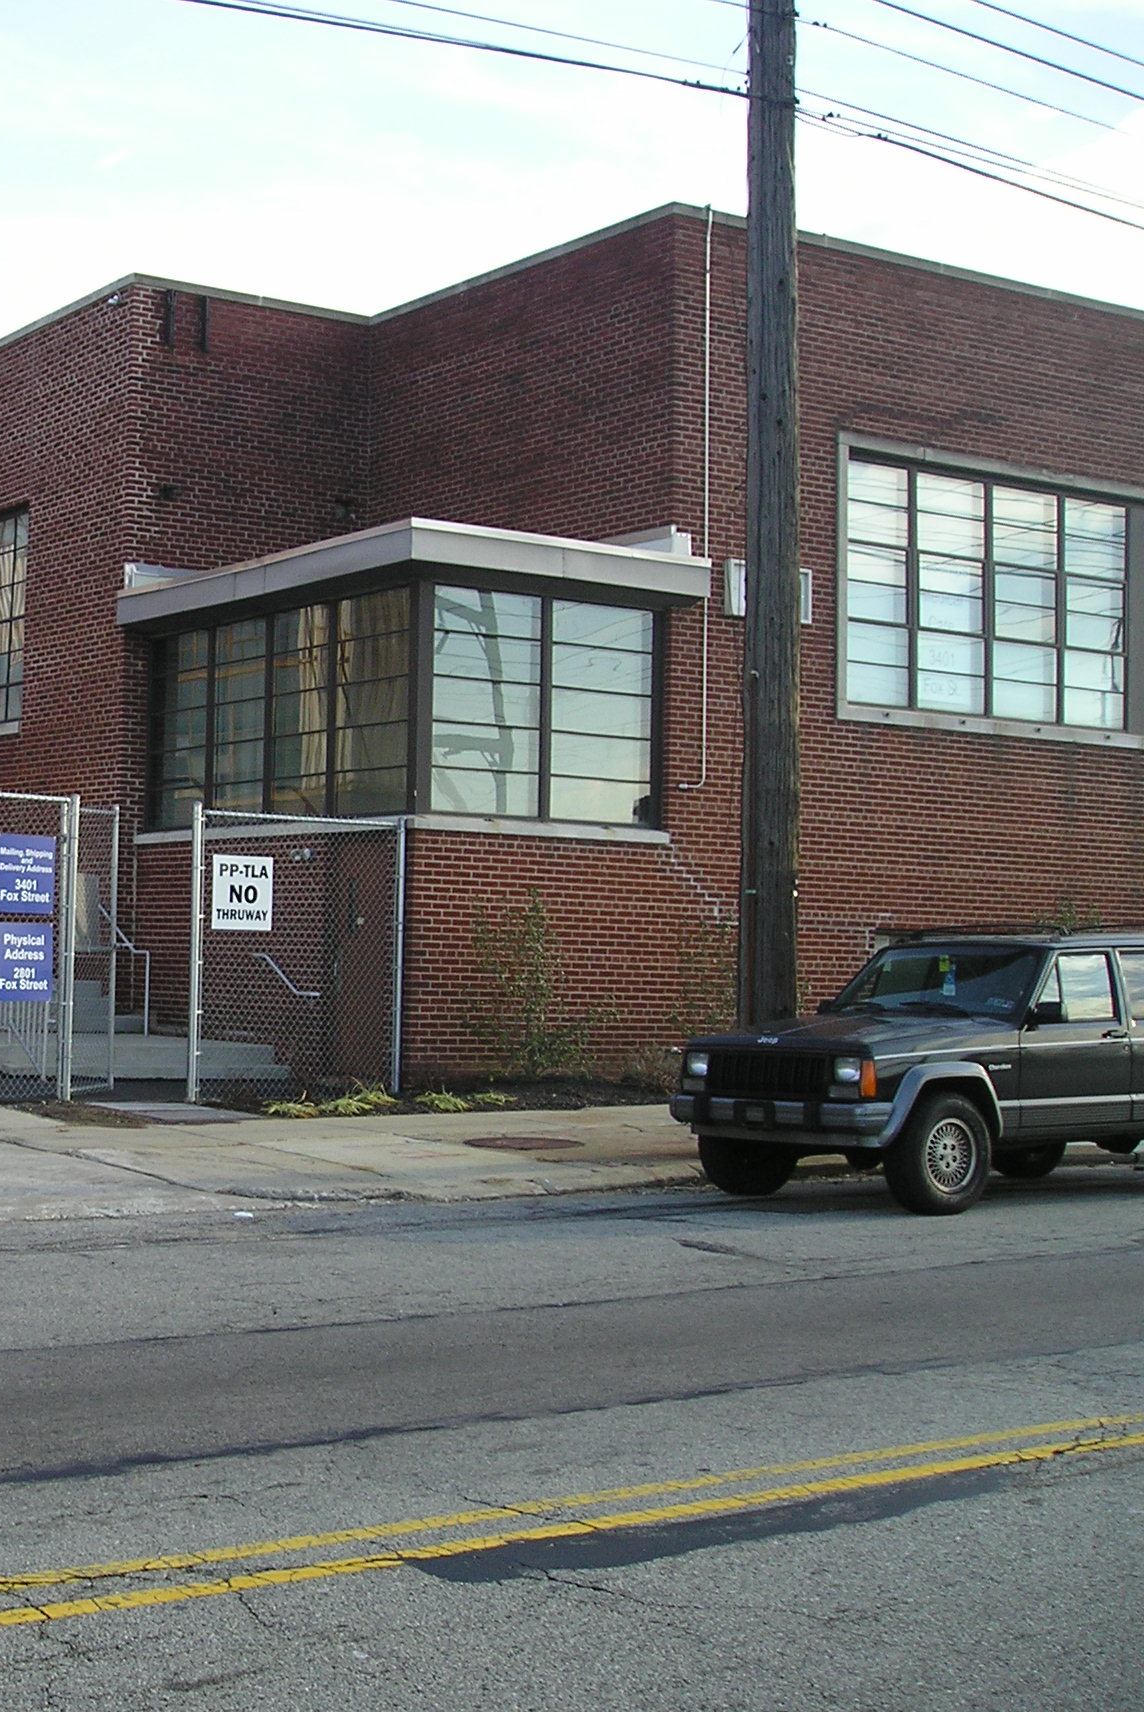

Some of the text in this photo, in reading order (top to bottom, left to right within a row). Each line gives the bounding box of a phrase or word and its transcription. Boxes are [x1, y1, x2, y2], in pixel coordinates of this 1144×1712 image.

[0, 847, 53, 860] Mailing, Shipping
[0, 863, 52, 874] Delivery Address
[219, 864, 268, 878] PP-TLA
[15, 879, 37, 890] 3401
[0, 890, 49, 903] Fox Street
[229, 885, 257, 903] NO
[216, 908, 268, 921] THRUWAY
[3, 933, 45, 947] Physical
[4, 948, 45, 961] Address
[13, 967, 35, 979] 2801
[0, 978, 48, 990] Fox Street
[757, 1035, 779, 1044] Jeep
